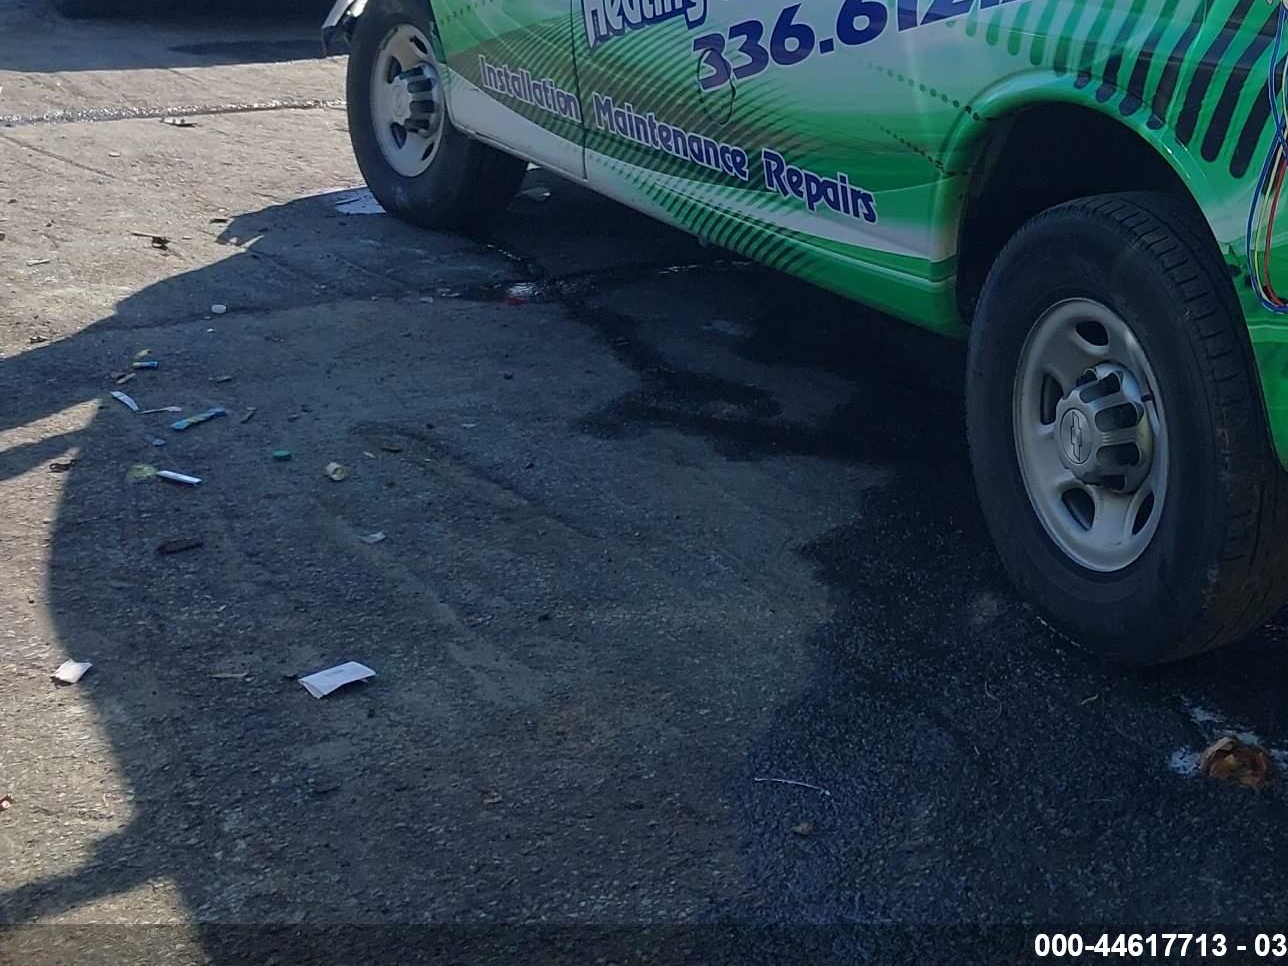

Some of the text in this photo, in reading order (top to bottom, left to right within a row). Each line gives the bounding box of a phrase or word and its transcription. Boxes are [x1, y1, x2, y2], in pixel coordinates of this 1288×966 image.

[479, 55, 878, 224] Installation Maintenance Repairs
